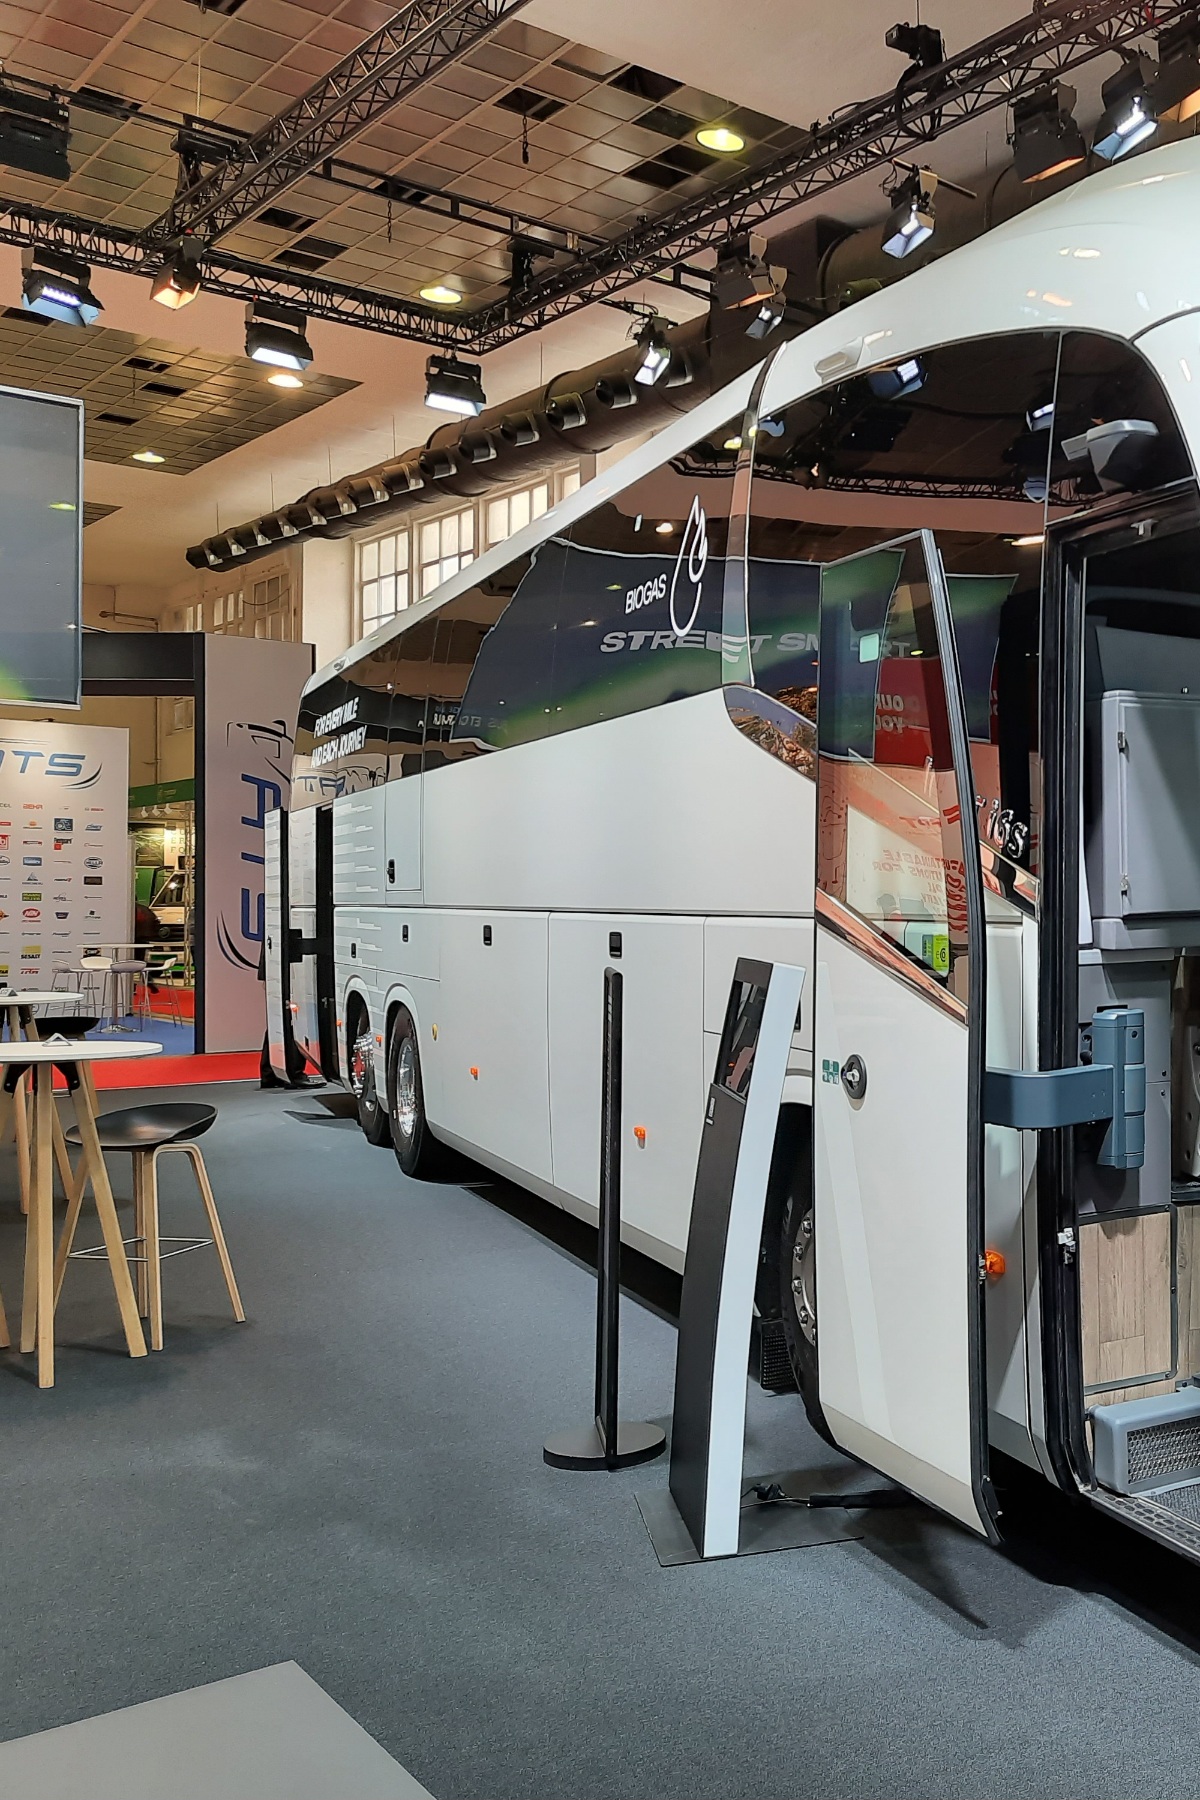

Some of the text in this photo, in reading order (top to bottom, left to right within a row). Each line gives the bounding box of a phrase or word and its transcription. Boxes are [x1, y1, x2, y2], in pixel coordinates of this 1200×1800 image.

[625, 573, 667, 614] BIOGAS
[325, 705, 344, 734] EVERY
[343, 696, 359, 724] MILE
[322, 738, 339, 765] EACH
[338, 724, 367, 758] JOURNEY
